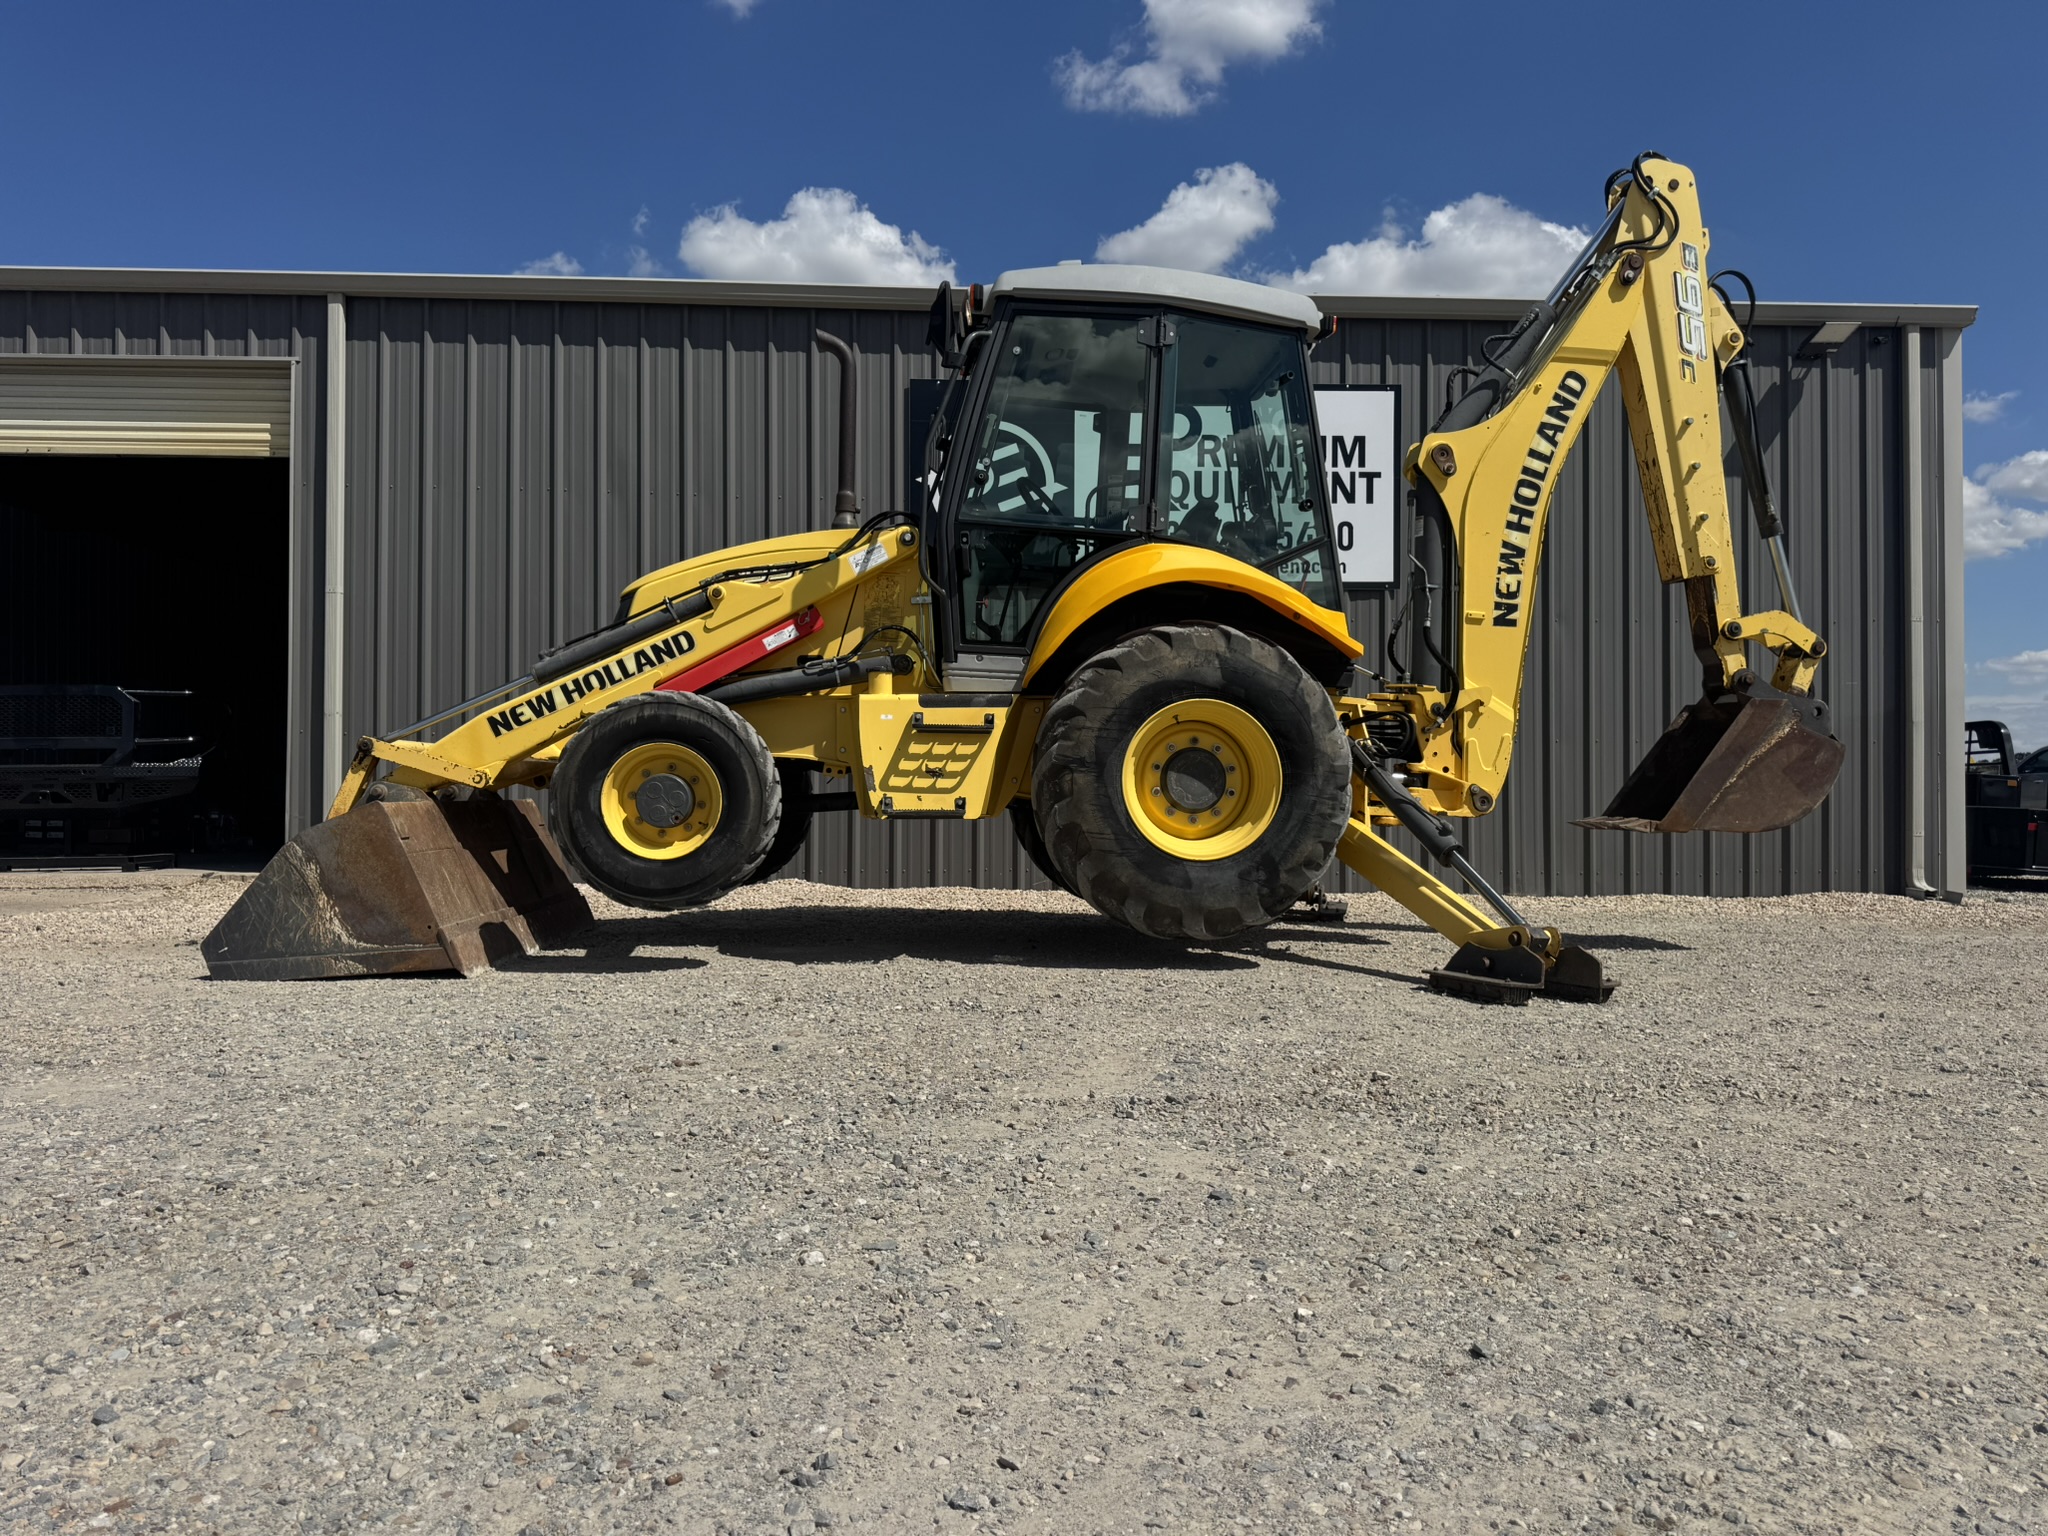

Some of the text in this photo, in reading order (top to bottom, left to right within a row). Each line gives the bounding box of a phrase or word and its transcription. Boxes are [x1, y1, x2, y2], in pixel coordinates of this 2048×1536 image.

[1492, 370, 1587, 628] NEW HOLLAND
[486, 689, 558, 738] NEW
[560, 630, 696, 705] HOLLAND
